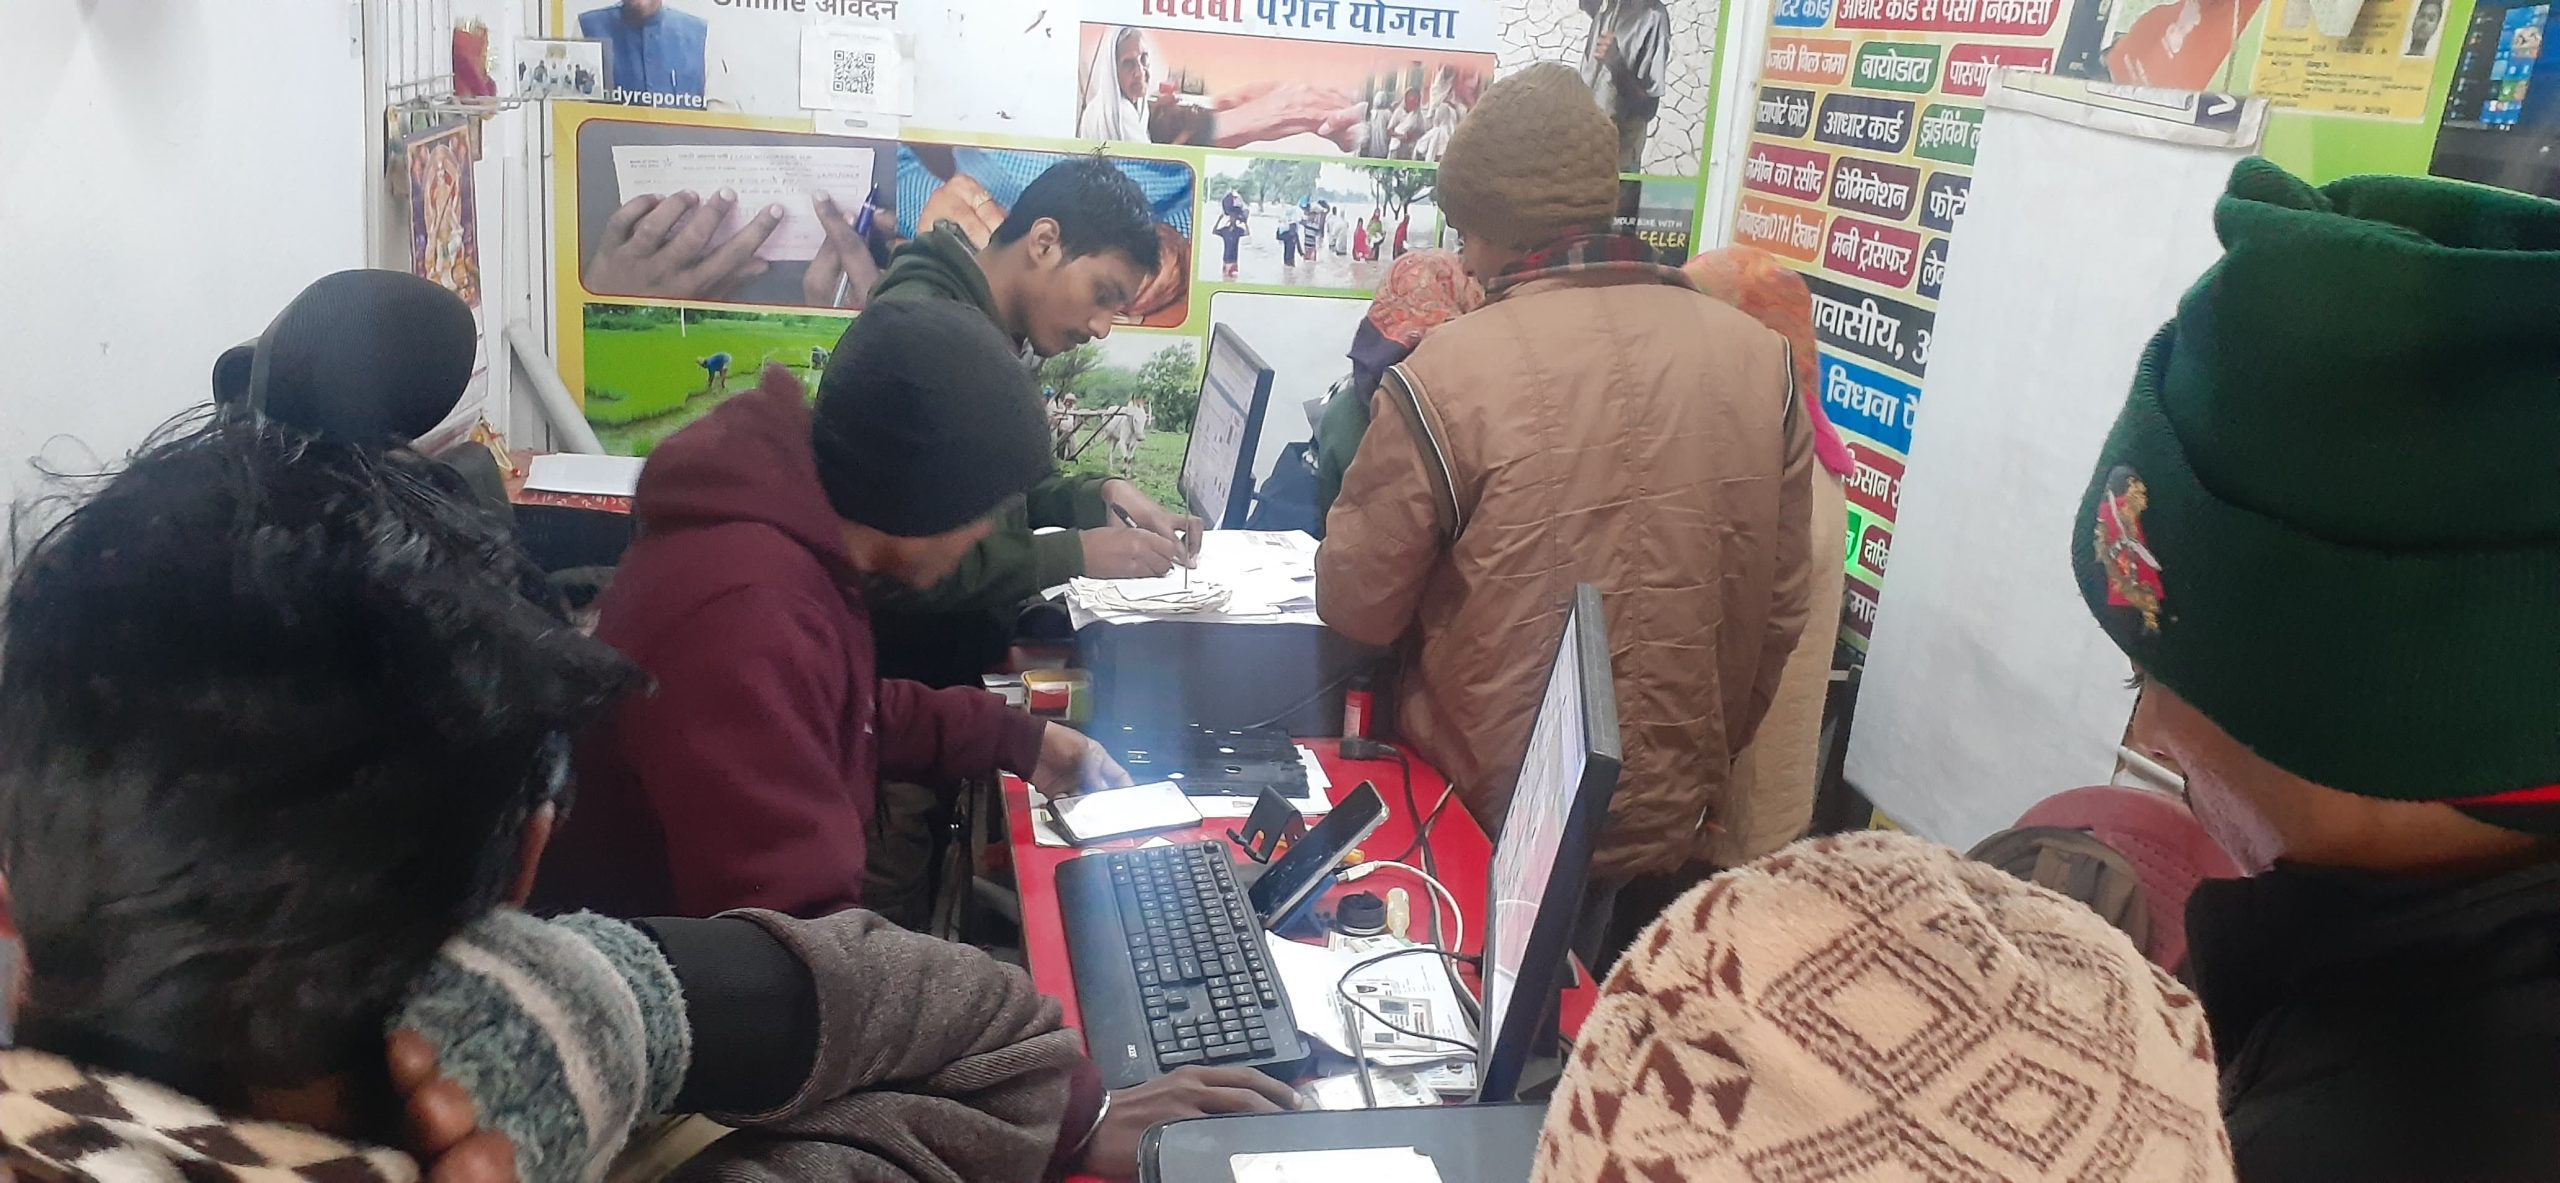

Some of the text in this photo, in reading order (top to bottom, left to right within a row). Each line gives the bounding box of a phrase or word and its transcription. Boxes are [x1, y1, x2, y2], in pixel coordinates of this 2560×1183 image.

[815, 0, 899, 21] आवदन
[1861, 48, 1933, 85] बायोडाटा
[1950, 55, 2000, 88] पासपोर्
[1823, 110, 1904, 144] आधार कार्ड
[1774, 163, 1794, 187] का
[1793, 160, 1825, 194] रसीद
[1636, 231, 1687, 248] EELER
[1831, 227, 1912, 276] मनी ट्रांसफर
[1826, 364, 1900, 428] विधवा
